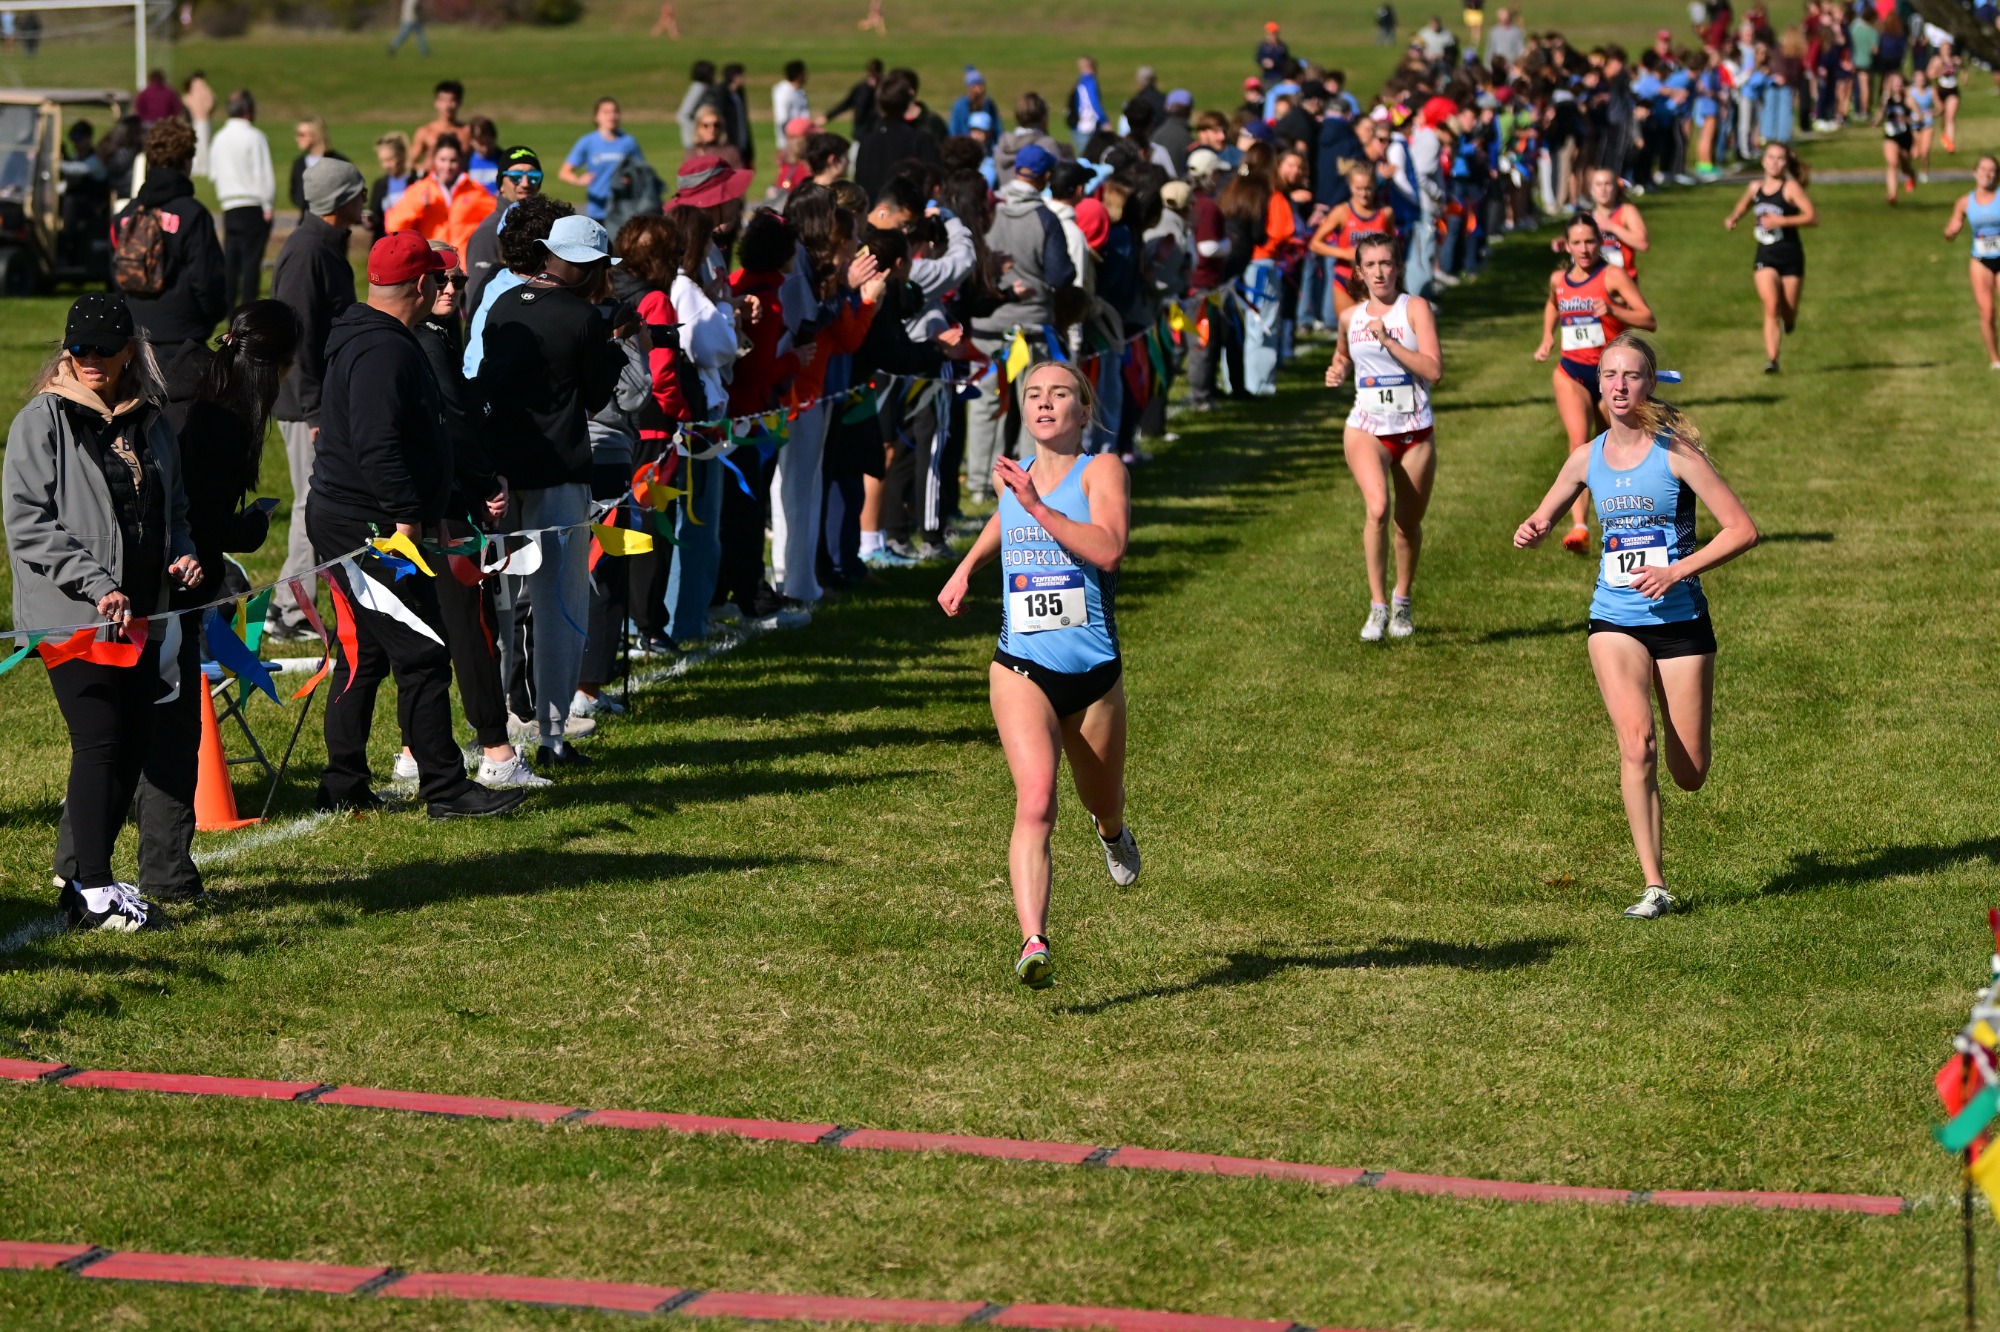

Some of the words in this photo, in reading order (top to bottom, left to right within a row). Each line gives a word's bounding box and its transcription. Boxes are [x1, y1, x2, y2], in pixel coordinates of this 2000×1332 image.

[1559, 297, 1594, 312] Bullet
[1351, 326, 1405, 344] DICKON
[1575, 328, 1589, 341] 61
[1378, 389, 1394, 404] 14
[1601, 495, 1654, 515] JOHNS
[1007, 526, 1055, 545] JOHN
[1620, 535, 1656, 544] CENTENNIAL
[1004, 549, 1086, 567] HOPKINS
[1617, 551, 1647, 573] 127
[1032, 575, 1070, 583] CENTENNIAL
[1024, 593, 1063, 617] 135
